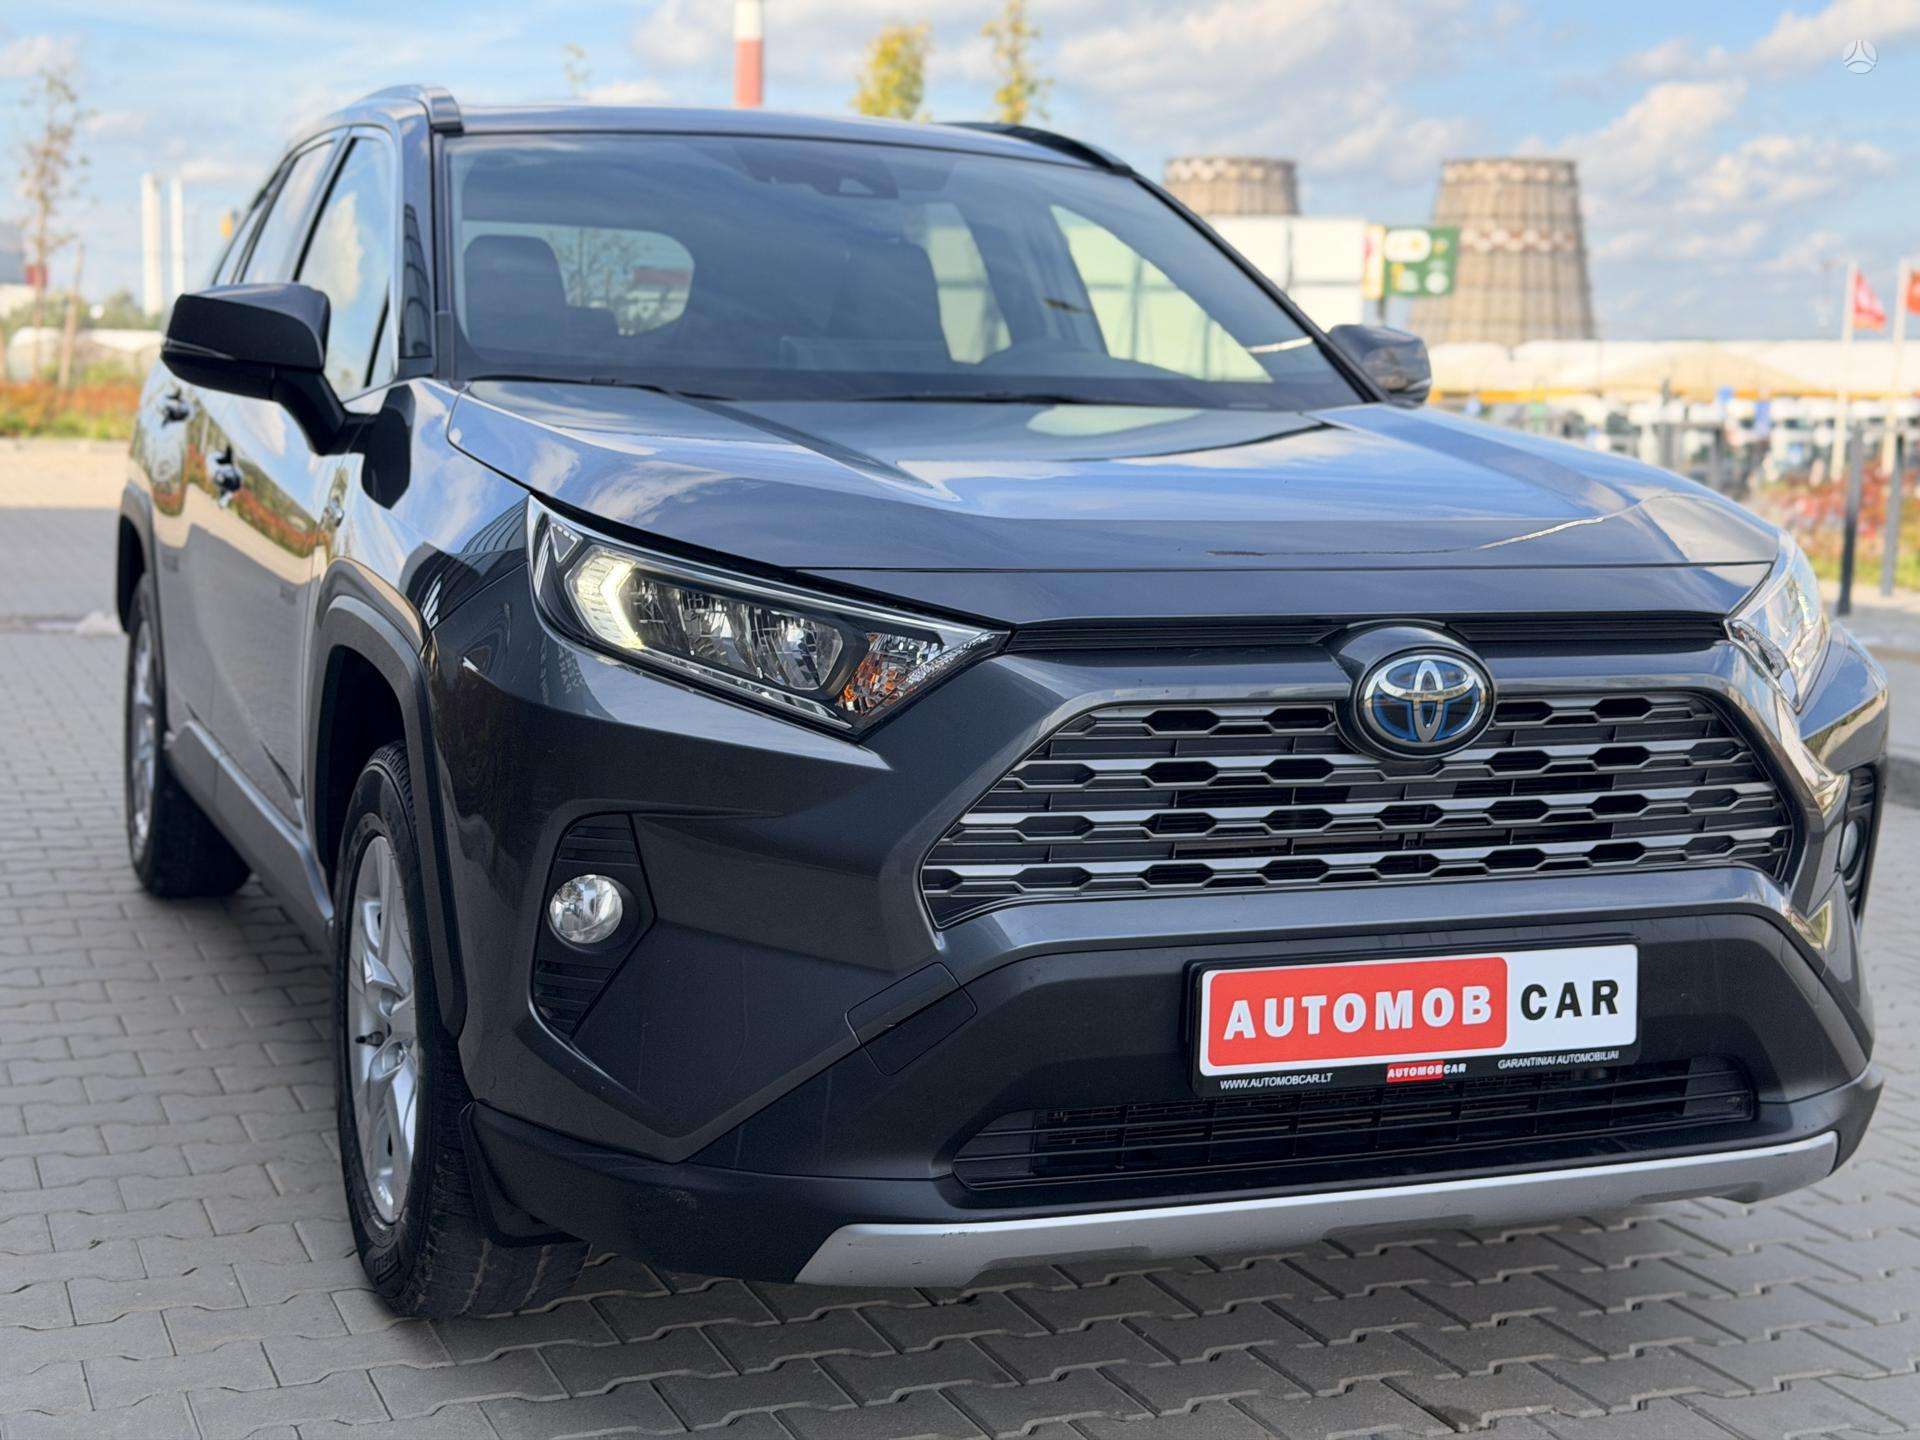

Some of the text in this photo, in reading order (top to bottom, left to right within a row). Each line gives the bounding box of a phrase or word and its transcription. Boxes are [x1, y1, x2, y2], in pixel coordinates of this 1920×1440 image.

[1223, 979, 1619, 1040] AUTOMOB CAR
[1498, 1050, 1619, 1069] GARANTINIAI AUTOMOBILIAI
[1220, 1072, 1333, 1090] WWW.AUTOMOBCAR.LT
